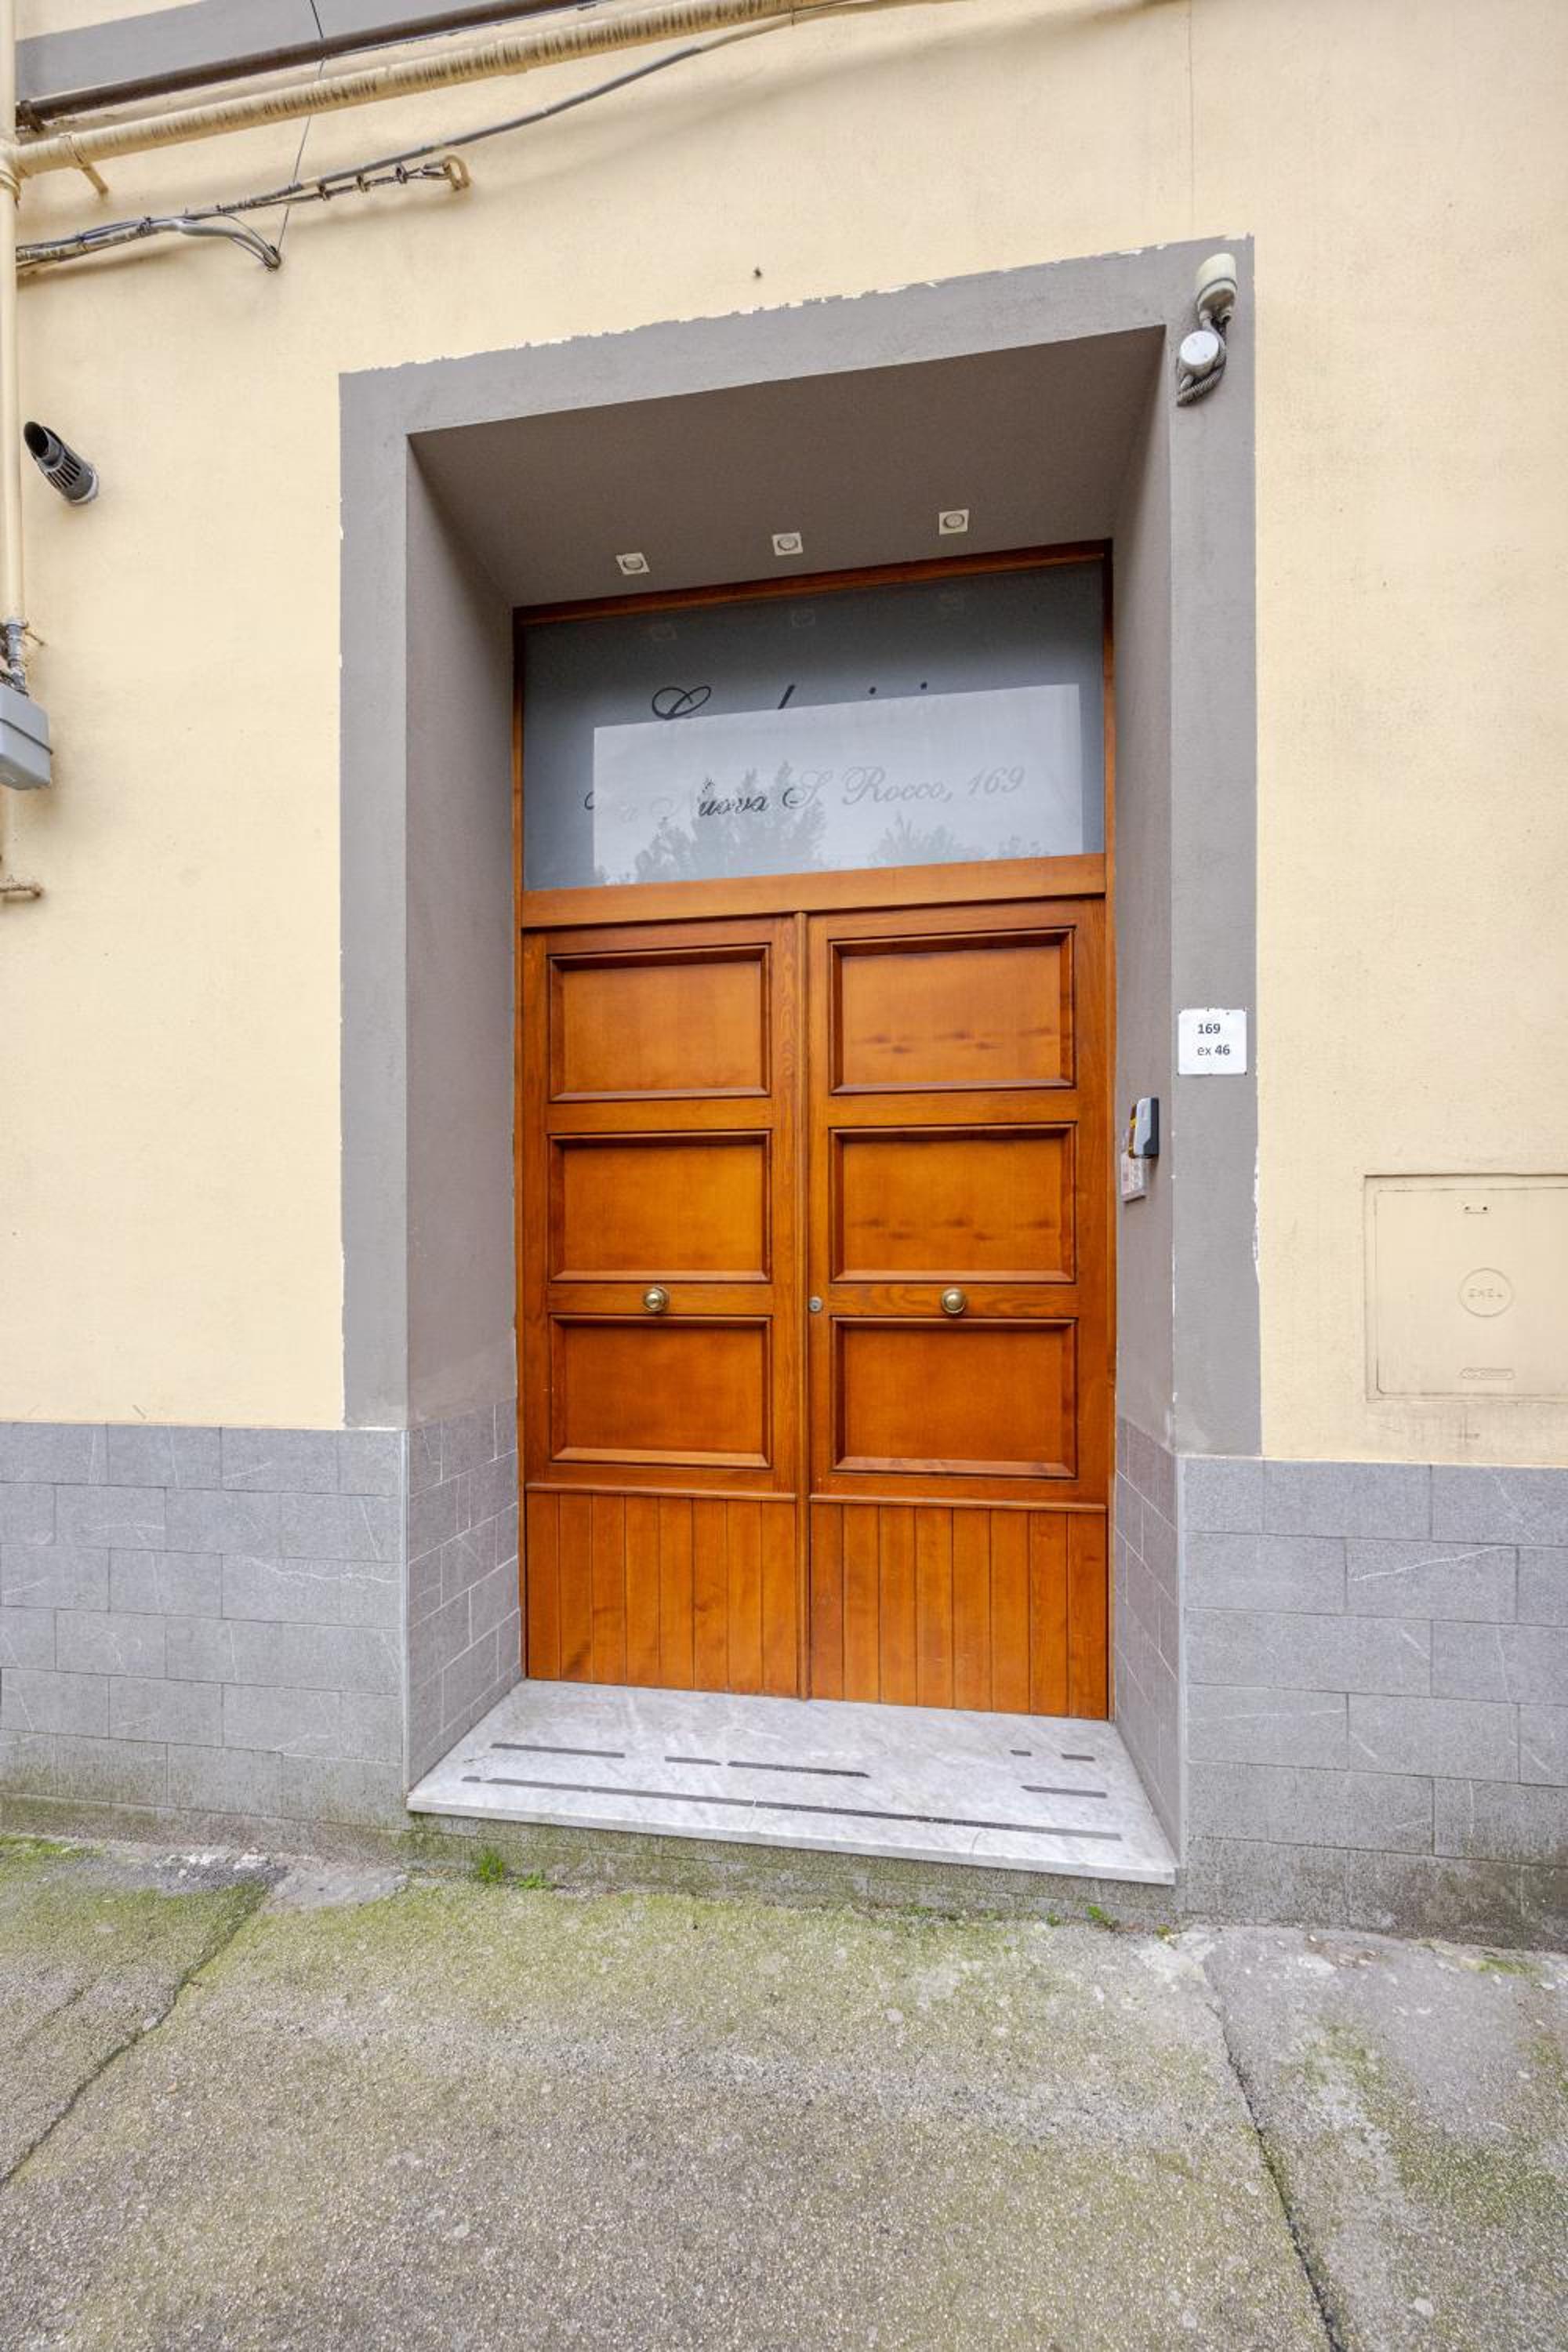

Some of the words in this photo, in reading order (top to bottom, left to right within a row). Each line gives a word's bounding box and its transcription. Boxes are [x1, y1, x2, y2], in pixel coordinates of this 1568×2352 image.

[842, 766, 953, 806] Rocco,
[967, 766, 1025, 795] 169
[1198, 1023, 1221, 1034] 169
[1197, 1047, 1211, 1055] ex
[1214, 1044, 1230, 1055] 46
